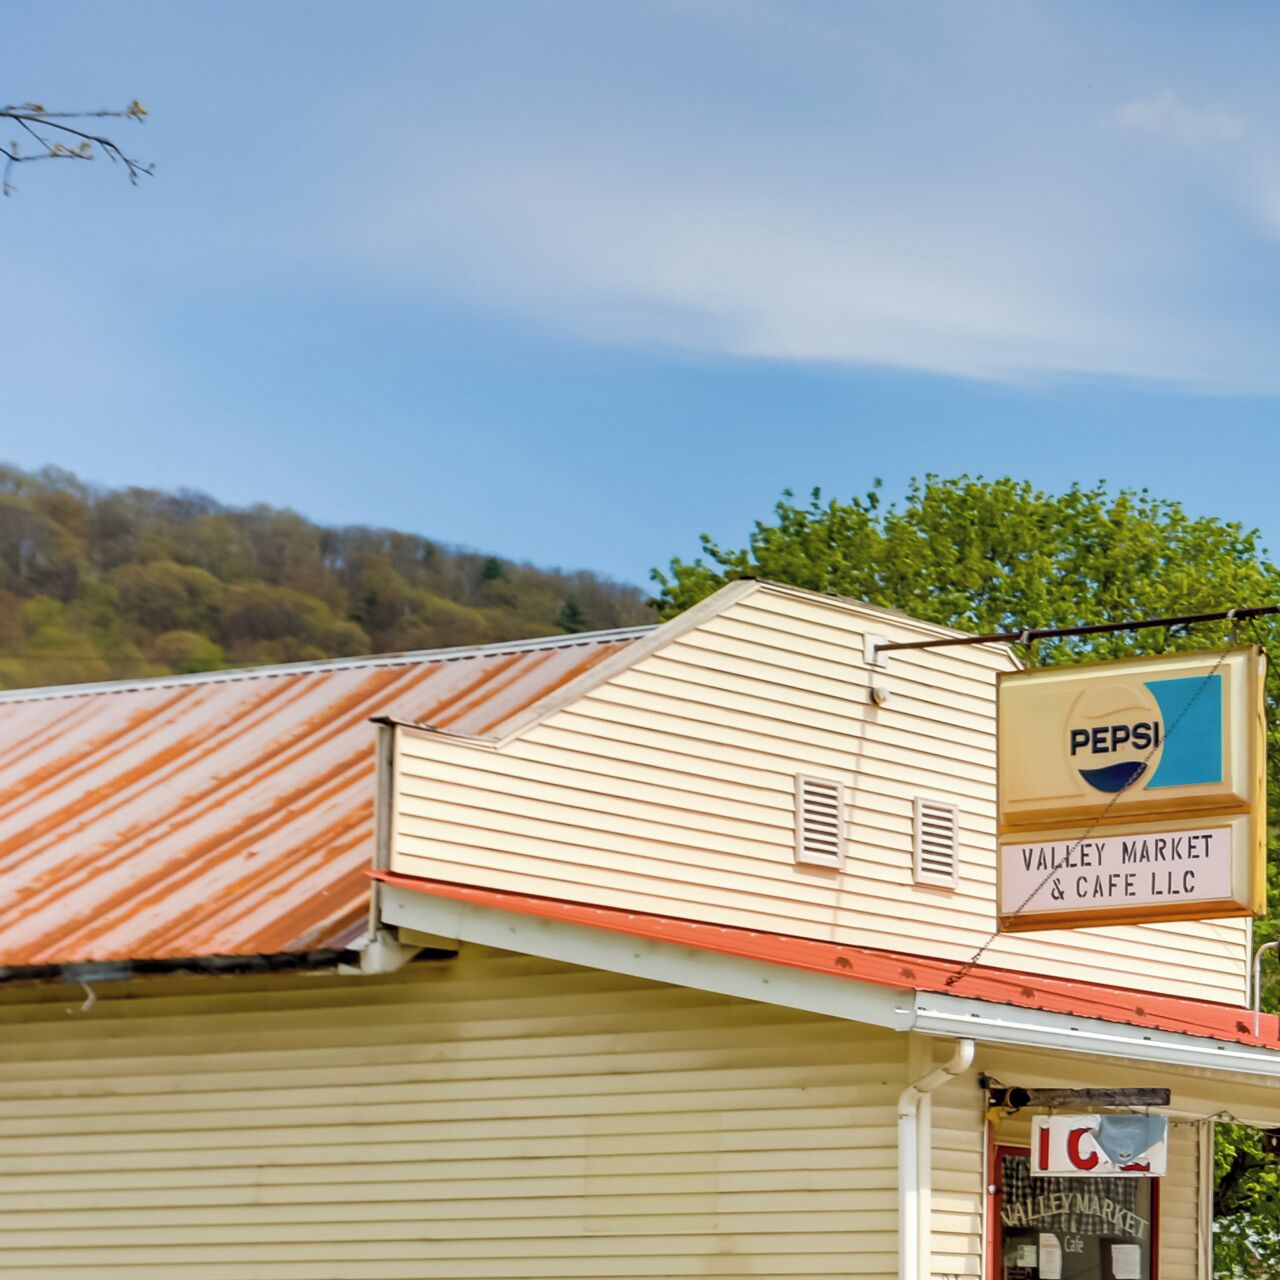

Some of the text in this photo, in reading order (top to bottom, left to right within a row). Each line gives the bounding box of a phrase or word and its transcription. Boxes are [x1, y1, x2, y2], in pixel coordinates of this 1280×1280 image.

[1070, 721, 1159, 756] PEPSI
[1022, 834, 1213, 871] VALLEY MARKET
[1051, 870, 1196, 900] & CAFE LLC
[1038, 1126, 1152, 1172] IC
[1000, 1192, 1150, 1239] VALLEY MARKET
[1064, 1235, 1084, 1253] Cafe
